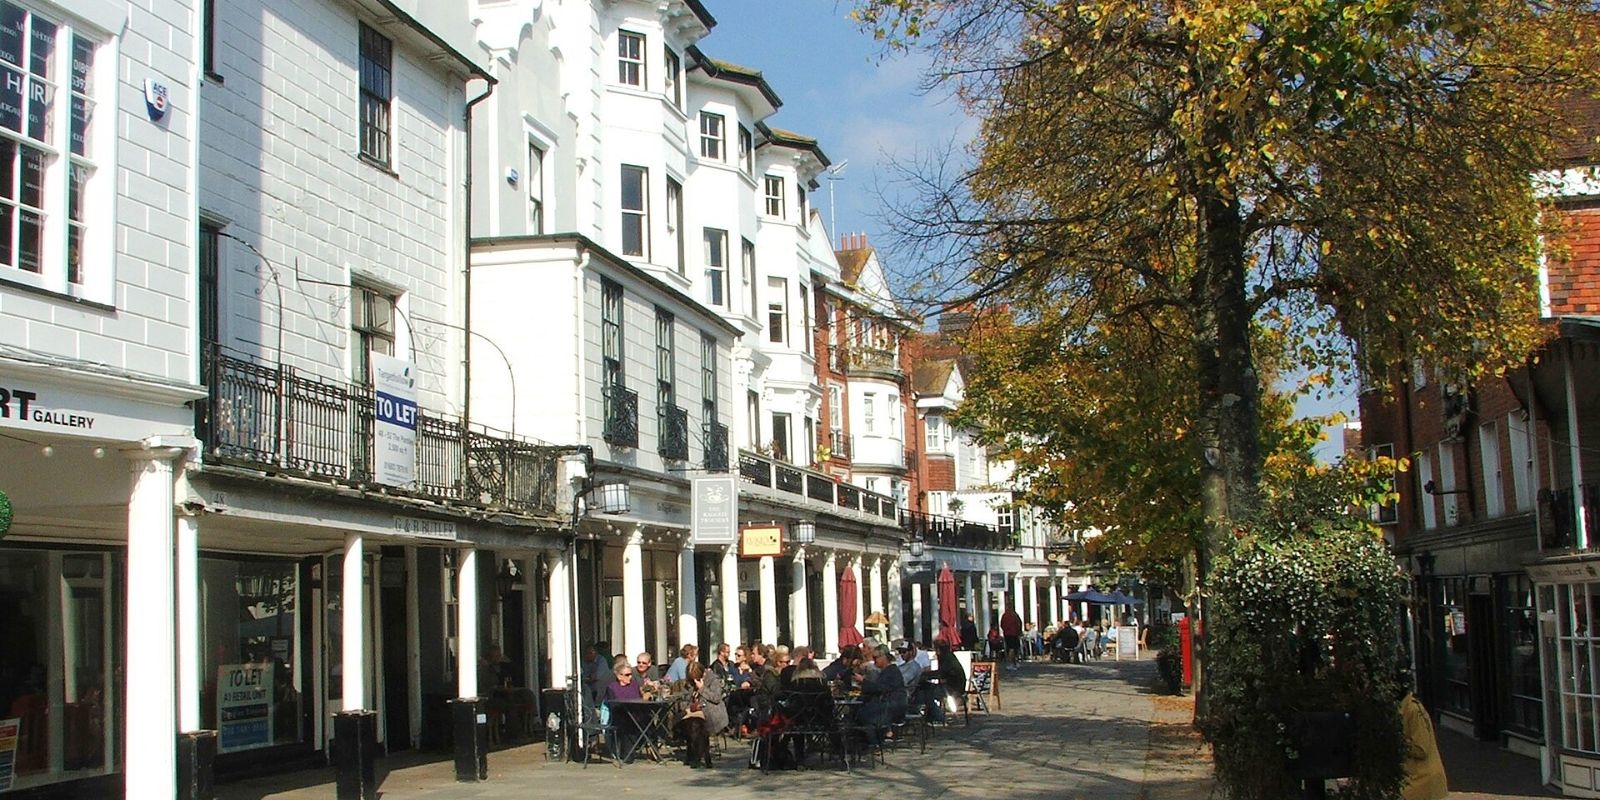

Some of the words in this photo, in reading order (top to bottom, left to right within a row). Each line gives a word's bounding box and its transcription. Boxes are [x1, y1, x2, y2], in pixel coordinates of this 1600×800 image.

[6, 72, 47, 106] HIR
[153, 83, 167, 96] ACE
[33, 410, 95, 429] GALLERY
[377, 396, 393, 419] TO
[395, 402, 417, 426] LET
[422, 520, 455, 538] BUTLER
[230, 669, 243, 687] TO
[245, 668, 264, 686] LET
